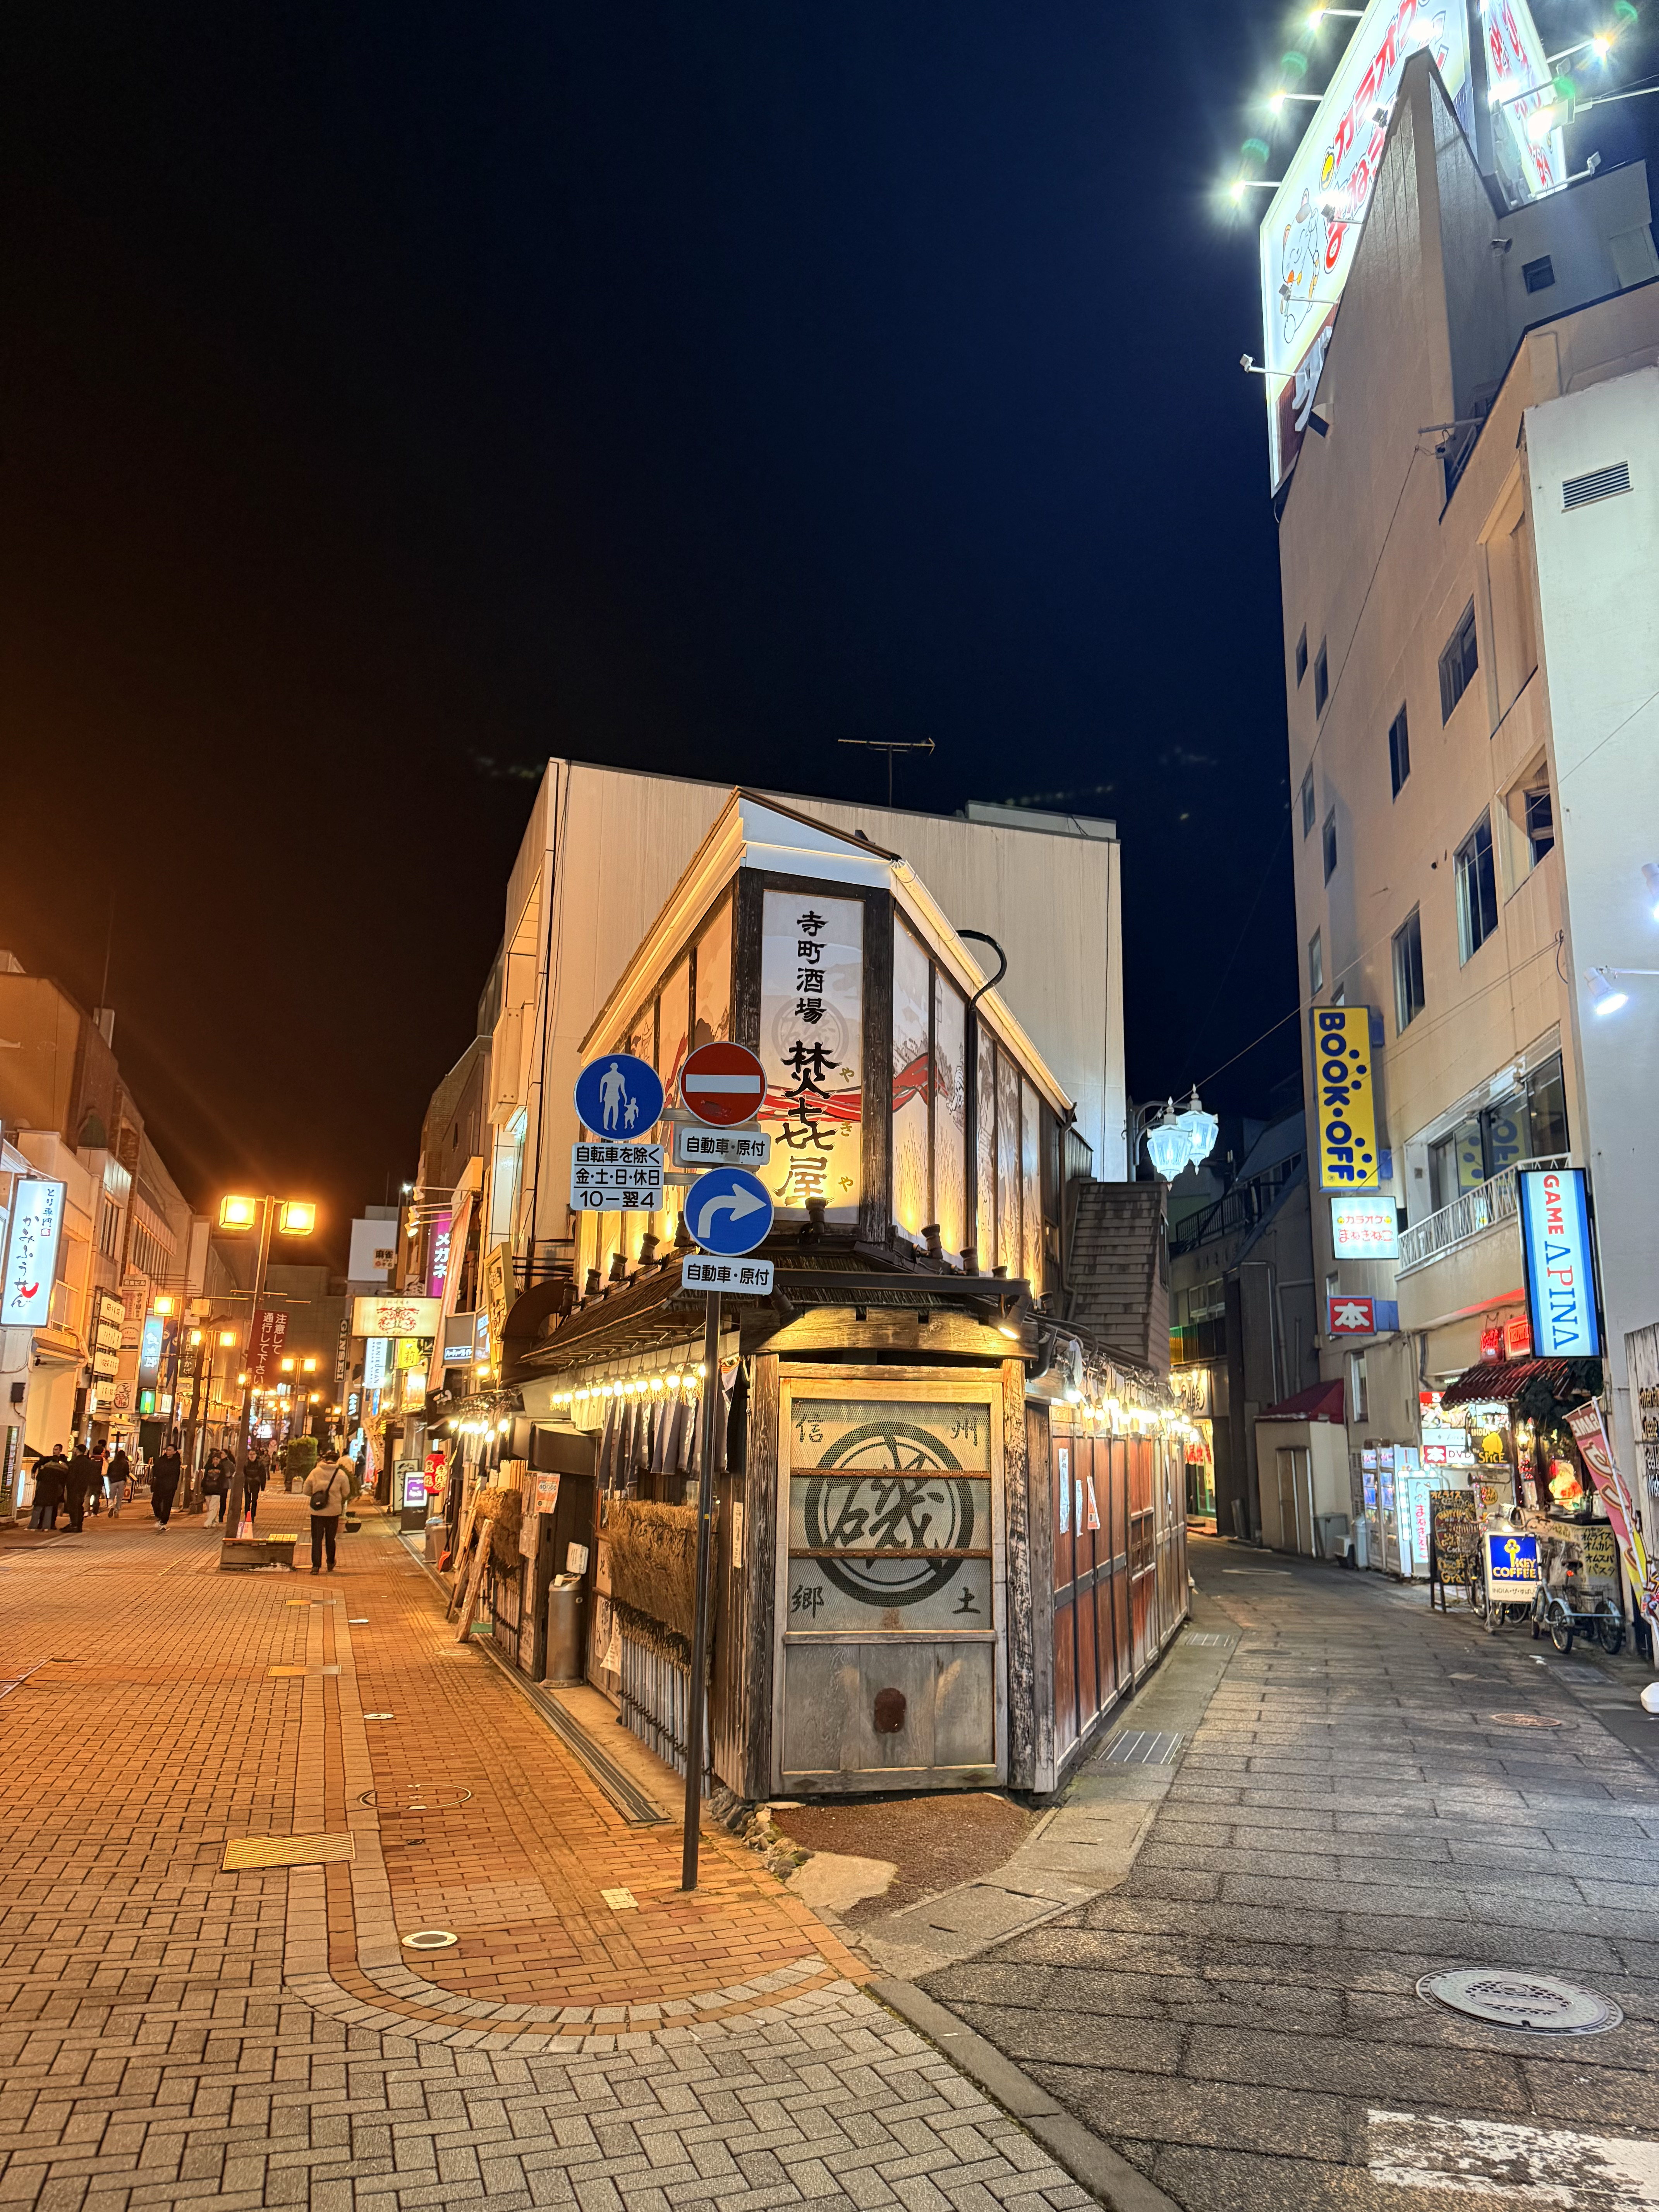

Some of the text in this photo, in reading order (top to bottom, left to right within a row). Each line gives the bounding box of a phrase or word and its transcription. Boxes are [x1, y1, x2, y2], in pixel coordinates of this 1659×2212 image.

[796, 910, 829, 1025] 寺町酒場
[576, 1146, 660, 1164] 自転車を除く
[687, 1136, 765, 1157] 自動車・原付
[576, 1169, 660, 1186] 金・土・日・休日
[1544, 1175, 1564, 1235] GAME
[1346, 1216, 1383, 1224] カラオケ
[1339, 1229, 1393, 1243] まねきねこ
[375, 1250, 393, 1259] 麻雀
[433, 1233, 450, 1278] メガネ
[687, 1264, 770, 1286] 自動車・原付
[1334, 1302, 1370, 1329] 本
[272, 1313, 287, 1355] 注意して
[254, 1312, 274, 1384] 通行して下さい
[796, 1413, 979, 1447] 信 州
[1471, 1428, 1490, 1437] INDIA
[1427, 1447, 1445, 1462] 本
[1492, 1566, 1537, 1579] COFFEE
[1515, 1558, 1536, 1568] KEY
[1589, 1563, 1615, 1577] パスタ
[790, 1585, 981, 1619] 郷 土
